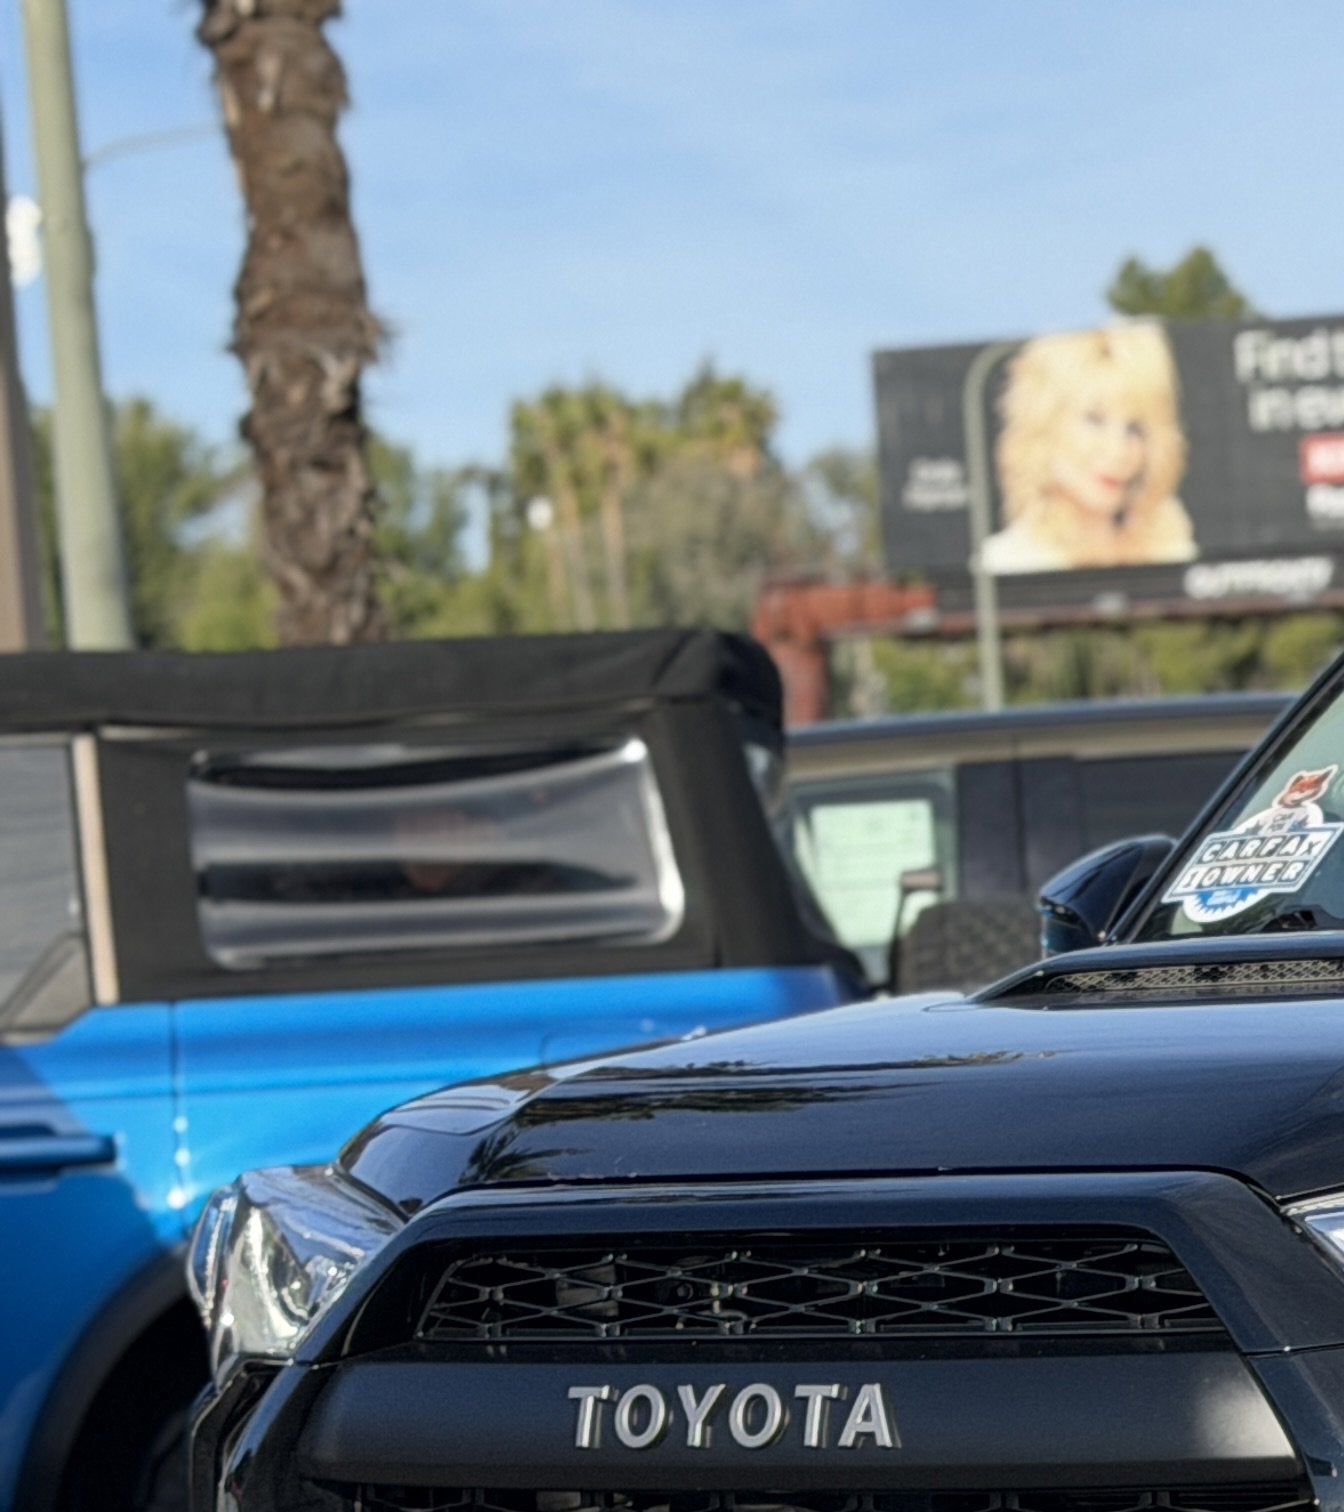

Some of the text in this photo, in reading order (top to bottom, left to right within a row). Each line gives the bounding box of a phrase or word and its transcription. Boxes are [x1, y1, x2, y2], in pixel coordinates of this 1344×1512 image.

[1201, 833, 1323, 862] CARFAX
[1201, 861, 1305, 886] OWNER
[567, 1382, 900, 1449] TOYOTA
